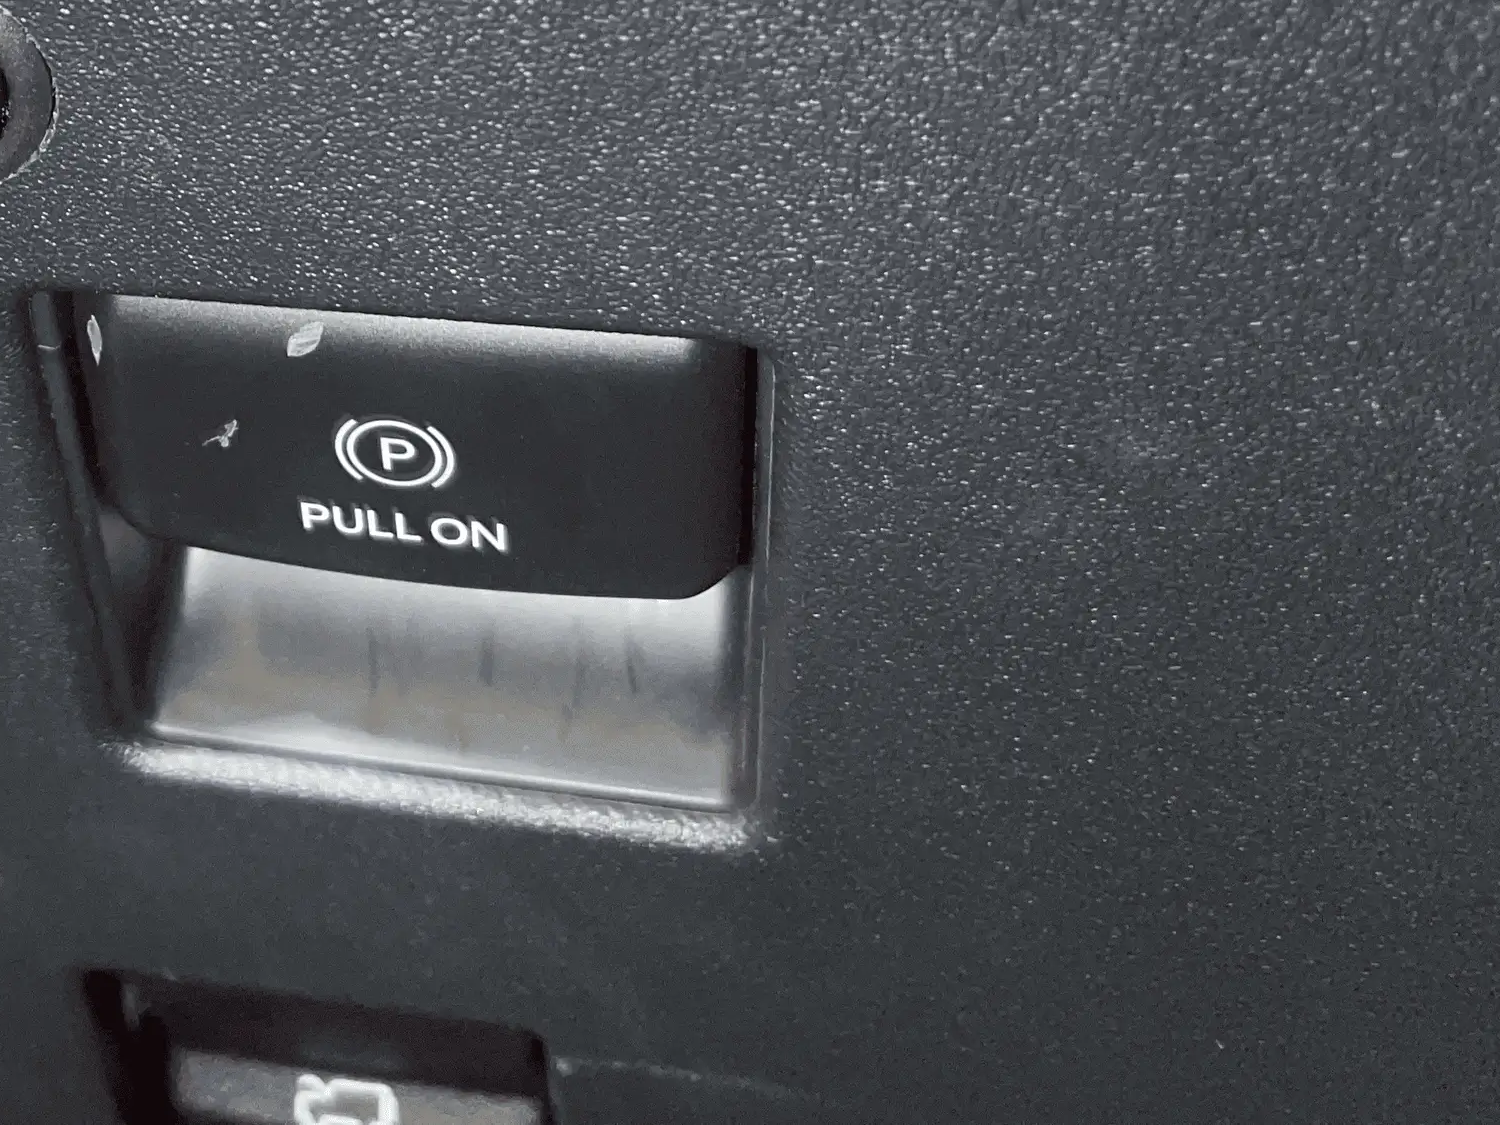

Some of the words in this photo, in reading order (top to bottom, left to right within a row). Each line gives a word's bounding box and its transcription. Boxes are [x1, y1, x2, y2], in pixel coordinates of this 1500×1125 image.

[379, 436, 416, 471] P
[299, 501, 423, 543] PULL
[429, 517, 509, 553] ON
